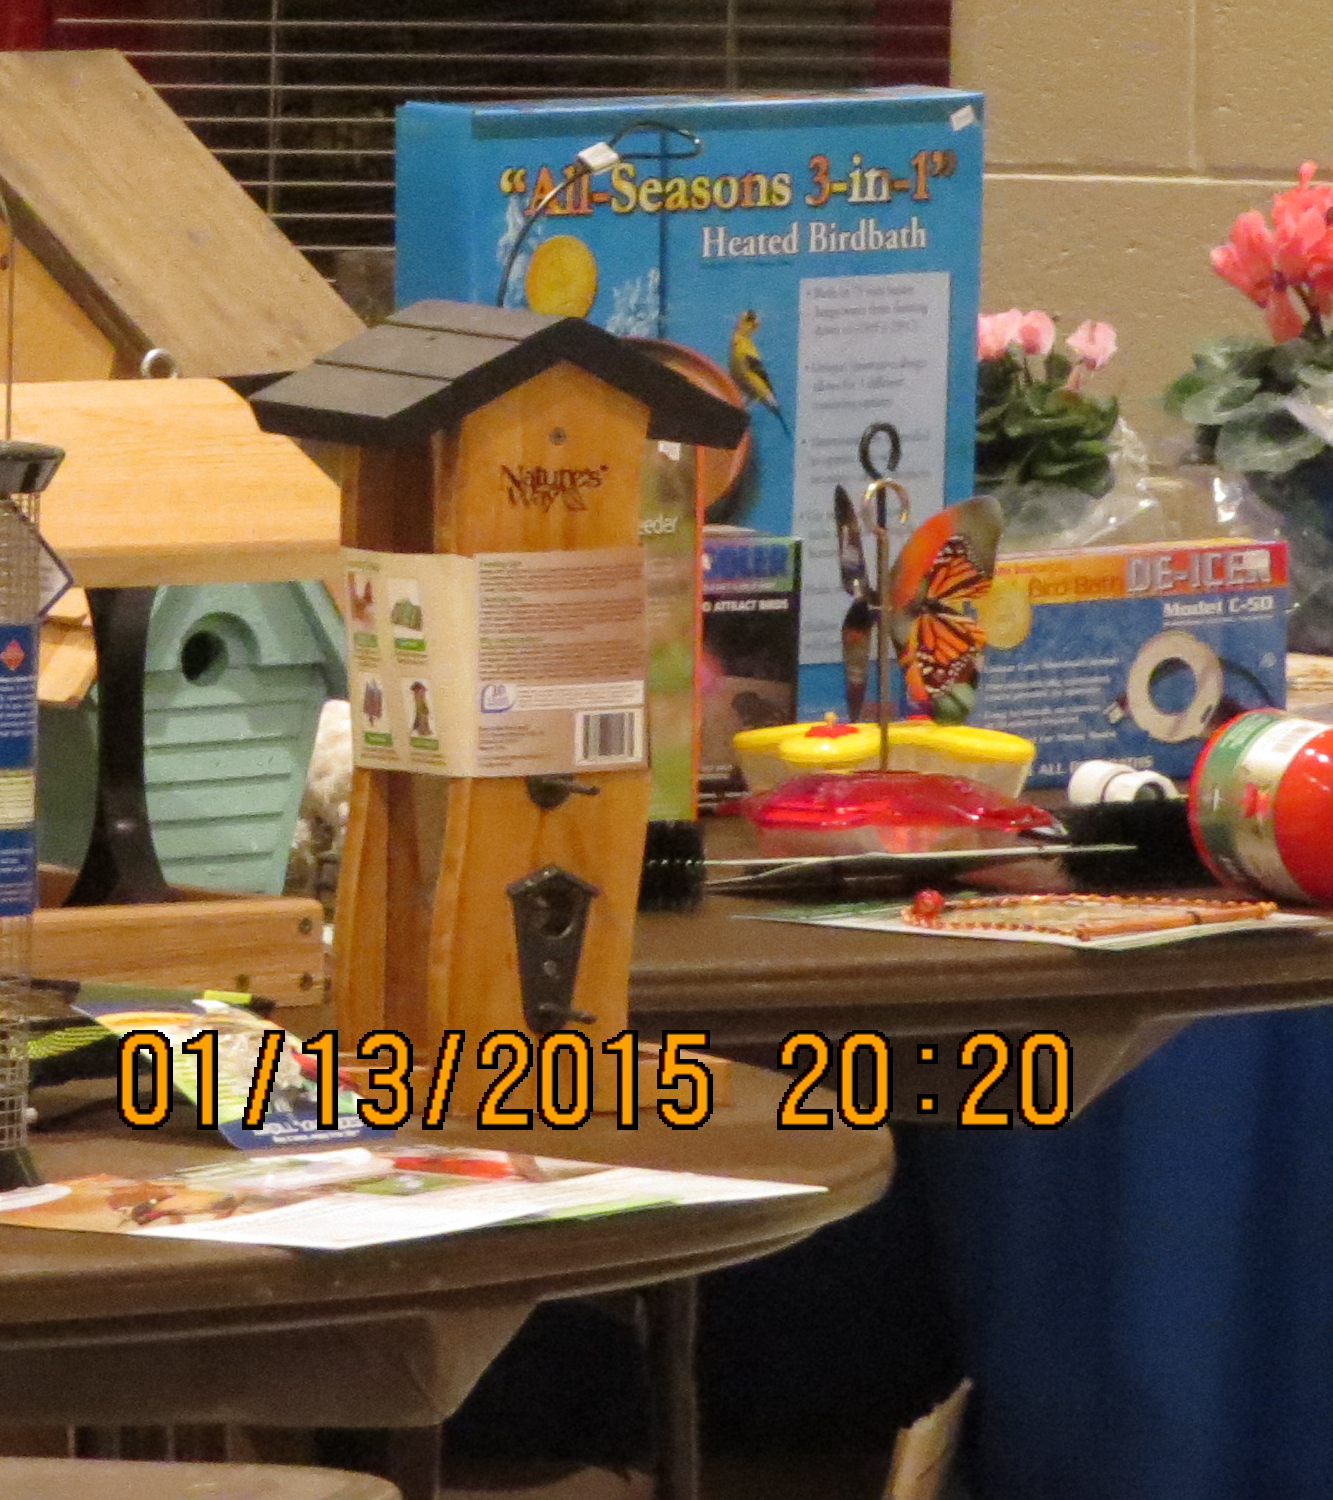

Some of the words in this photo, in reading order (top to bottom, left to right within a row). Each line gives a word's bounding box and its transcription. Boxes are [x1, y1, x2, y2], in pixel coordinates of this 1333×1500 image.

[702, 222, 799, 258] Heated
[808, 216, 927, 253] Birdbath
[715, 600, 757, 612] ATTRACT
[759, 598, 789, 611] BIRDS
[1163, 602, 1223, 617] Model
